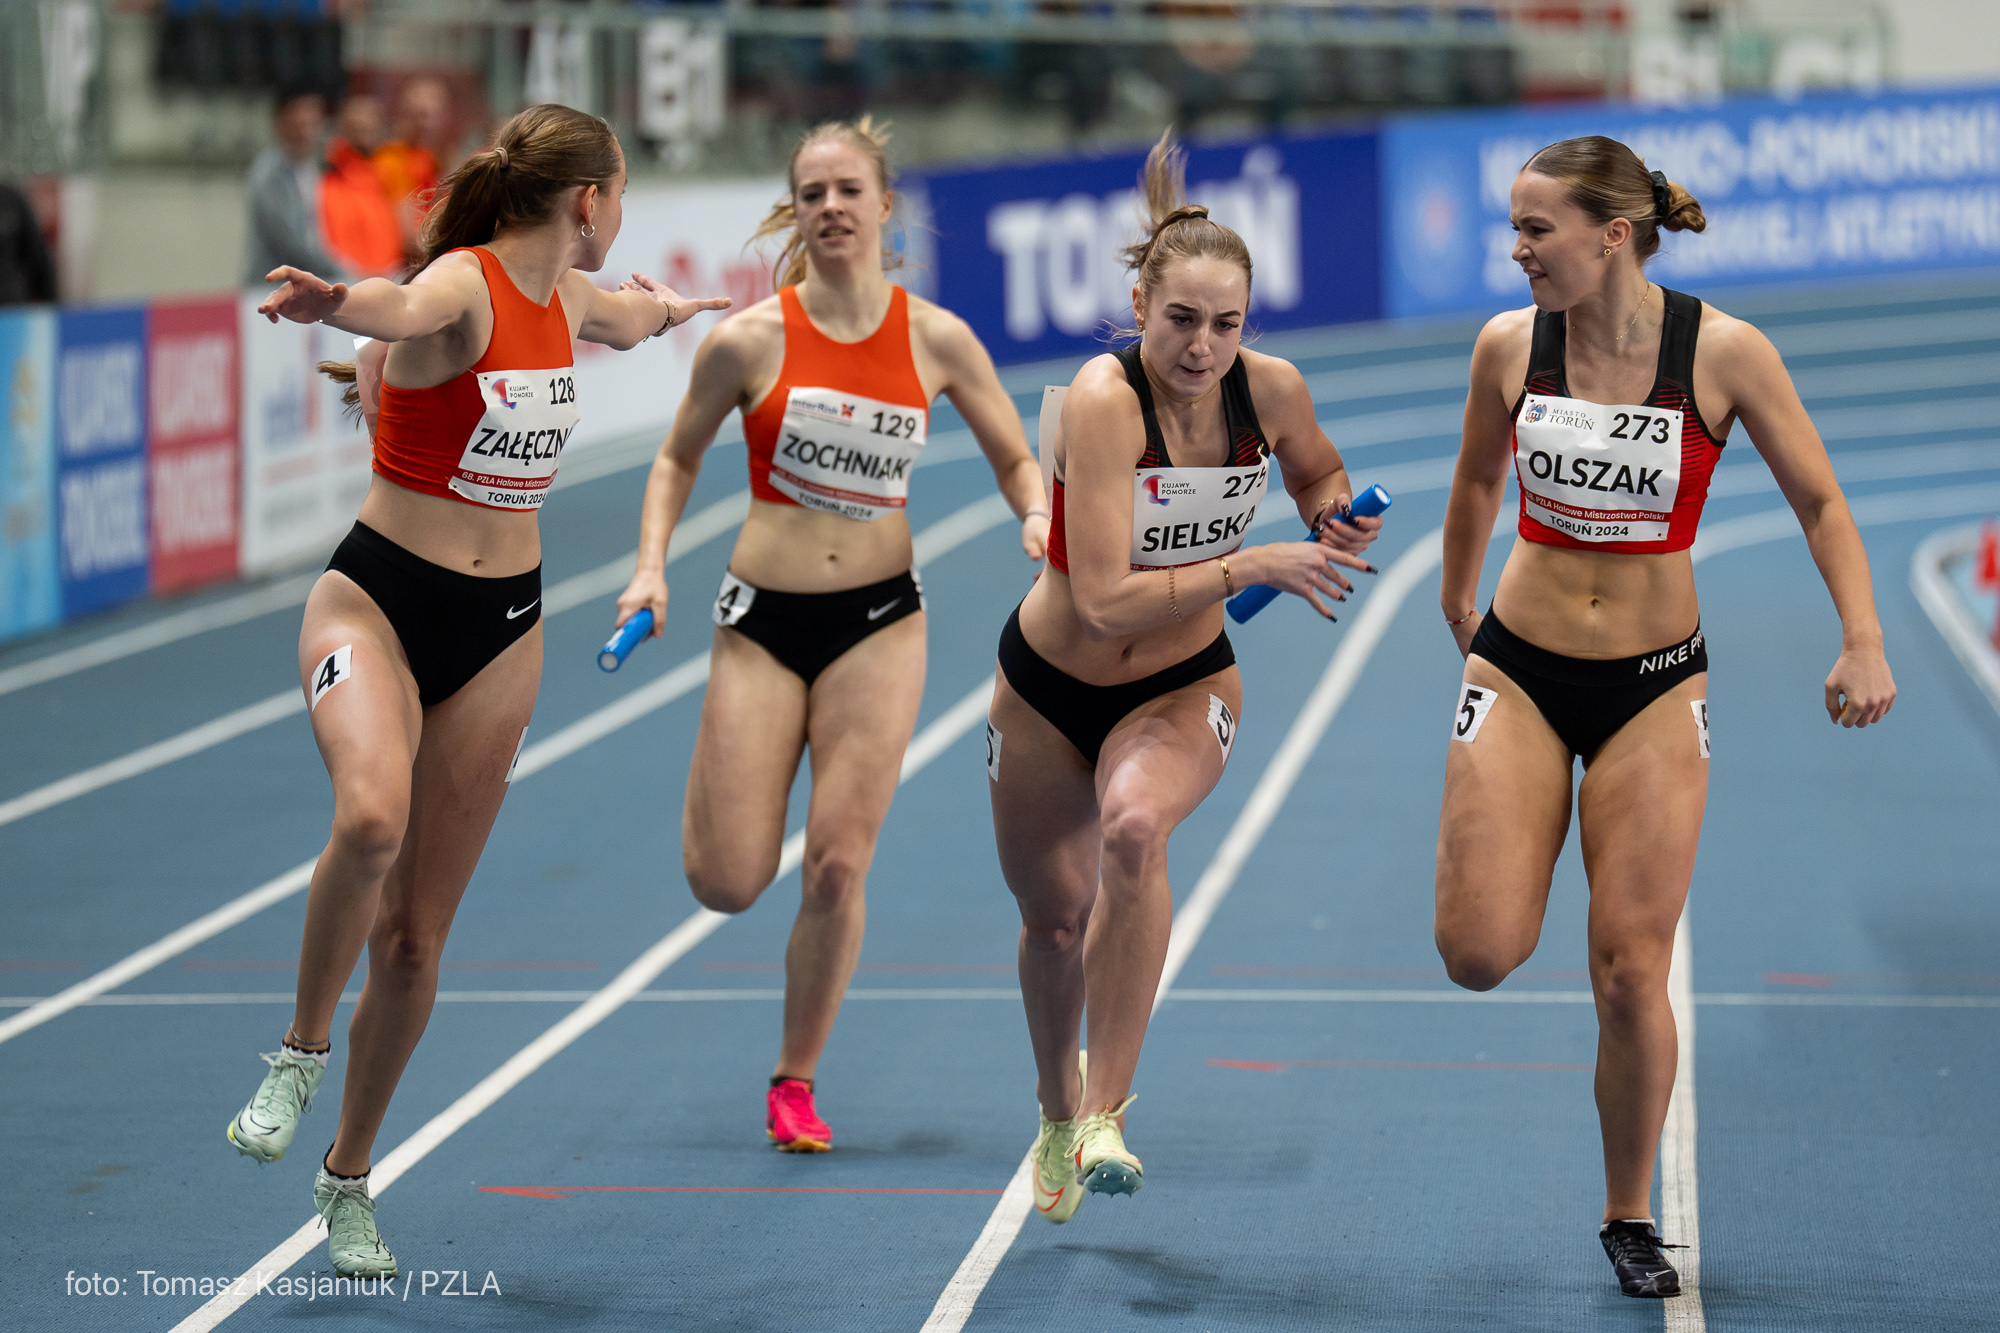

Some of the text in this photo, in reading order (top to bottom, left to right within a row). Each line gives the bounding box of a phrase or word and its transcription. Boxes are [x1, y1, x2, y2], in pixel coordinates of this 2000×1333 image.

[549, 376, 575, 405] 128
[870, 411, 917, 439] 129
[1549, 414, 1595, 430] TORUŃ
[1552, 408, 1587, 418] MIASTO
[1609, 412, 1670, 444] 273
[470, 427, 573, 466] ZAŁĘCZN
[781, 433, 911, 481] ZOCHNIAK
[461, 471, 475, 481] 68.
[476, 475, 495, 485] PZLA
[496, 478, 524, 488] Halowe
[1222, 465, 1267, 499] 275
[1528, 450, 1664, 497] OLSZAK
[487, 491, 528, 504] TORUŃ
[841, 504, 873, 518] 2024
[1535, 496, 1552, 508] PZLA
[1553, 502, 1583, 517] Halowe
[1584, 510, 1637, 520] Mistrzostwa
[1638, 511, 1665, 520] Polski
[1141, 504, 1256, 553] SIELSKA
[1549, 514, 1629, 536] TORUŃ 2024
[719, 585, 741, 621] 4
[1639, 629, 1703, 674] NIKE PR
[315, 654, 340, 695] 4
[1217, 703, 1233, 747] 5
[1456, 688, 1483, 737] 5
